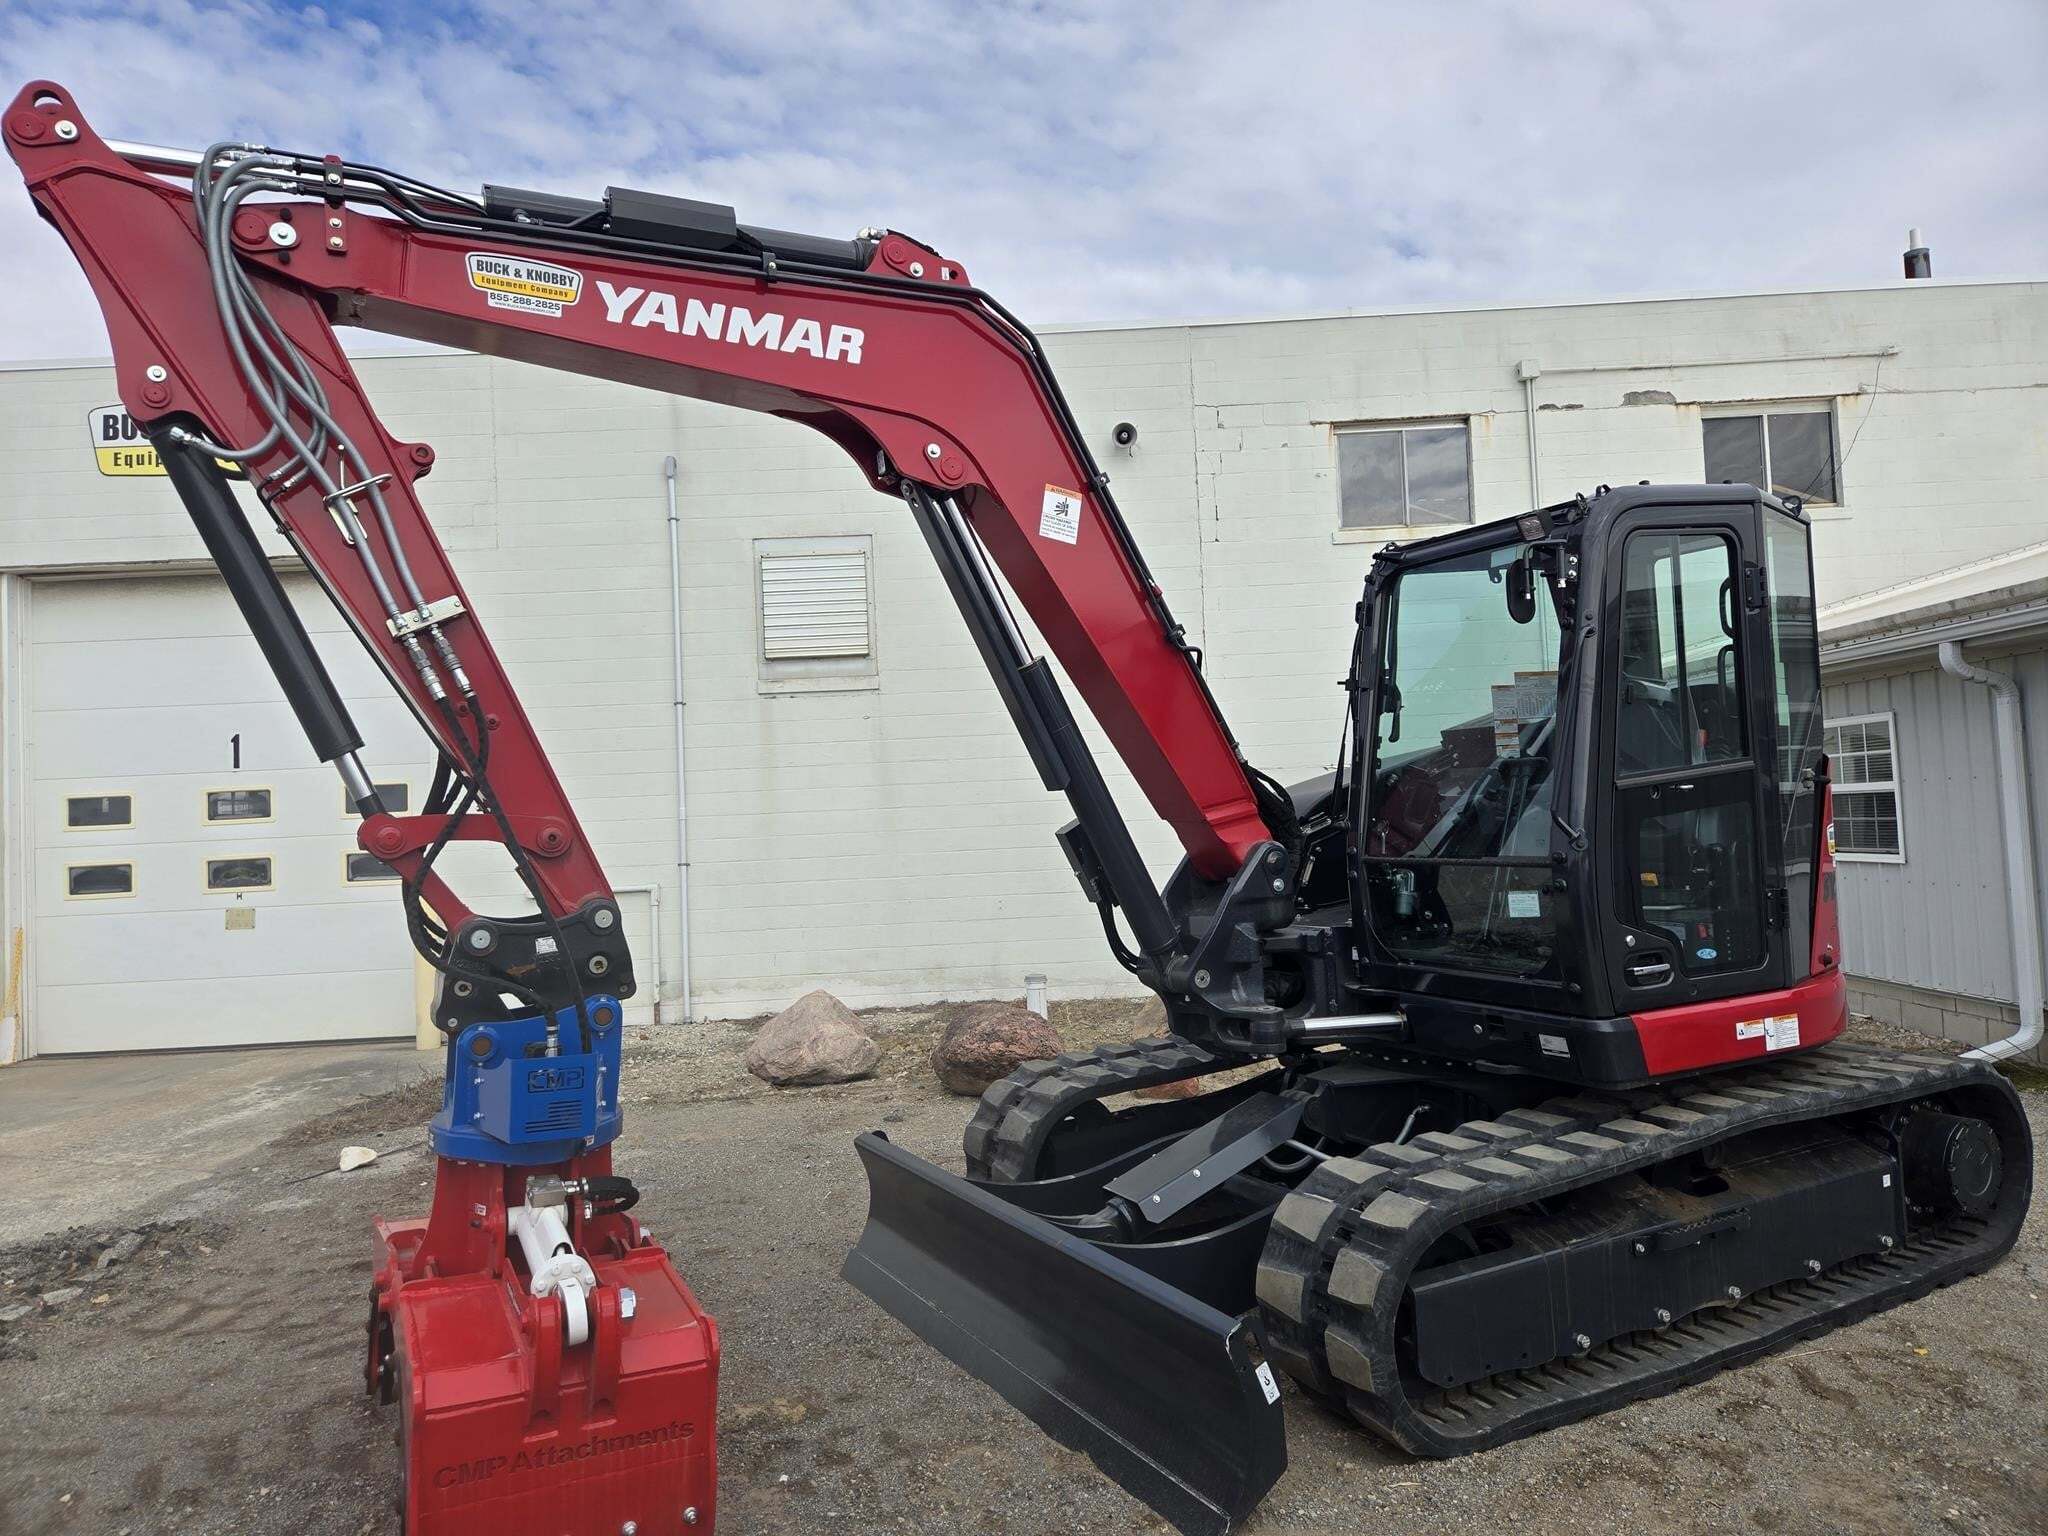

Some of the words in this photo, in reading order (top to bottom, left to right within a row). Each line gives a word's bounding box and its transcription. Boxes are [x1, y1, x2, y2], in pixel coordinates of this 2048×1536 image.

[476, 259, 510, 277] BUCK
[514, 268, 523, 278] &
[526, 268, 575, 287] KNOBBY
[481, 276, 527, 290] Equipment
[530, 284, 569, 298] Company
[490, 292, 561, 311] 855-288-2825
[595, 280, 865, 364] YANMAR
[103, 414, 150, 441] BU
[230, 733, 241, 769] 1
[529, 1068, 583, 1092] CMP
[433, 1456, 508, 1490] CMP
[509, 1420, 696, 1473] Attachments
